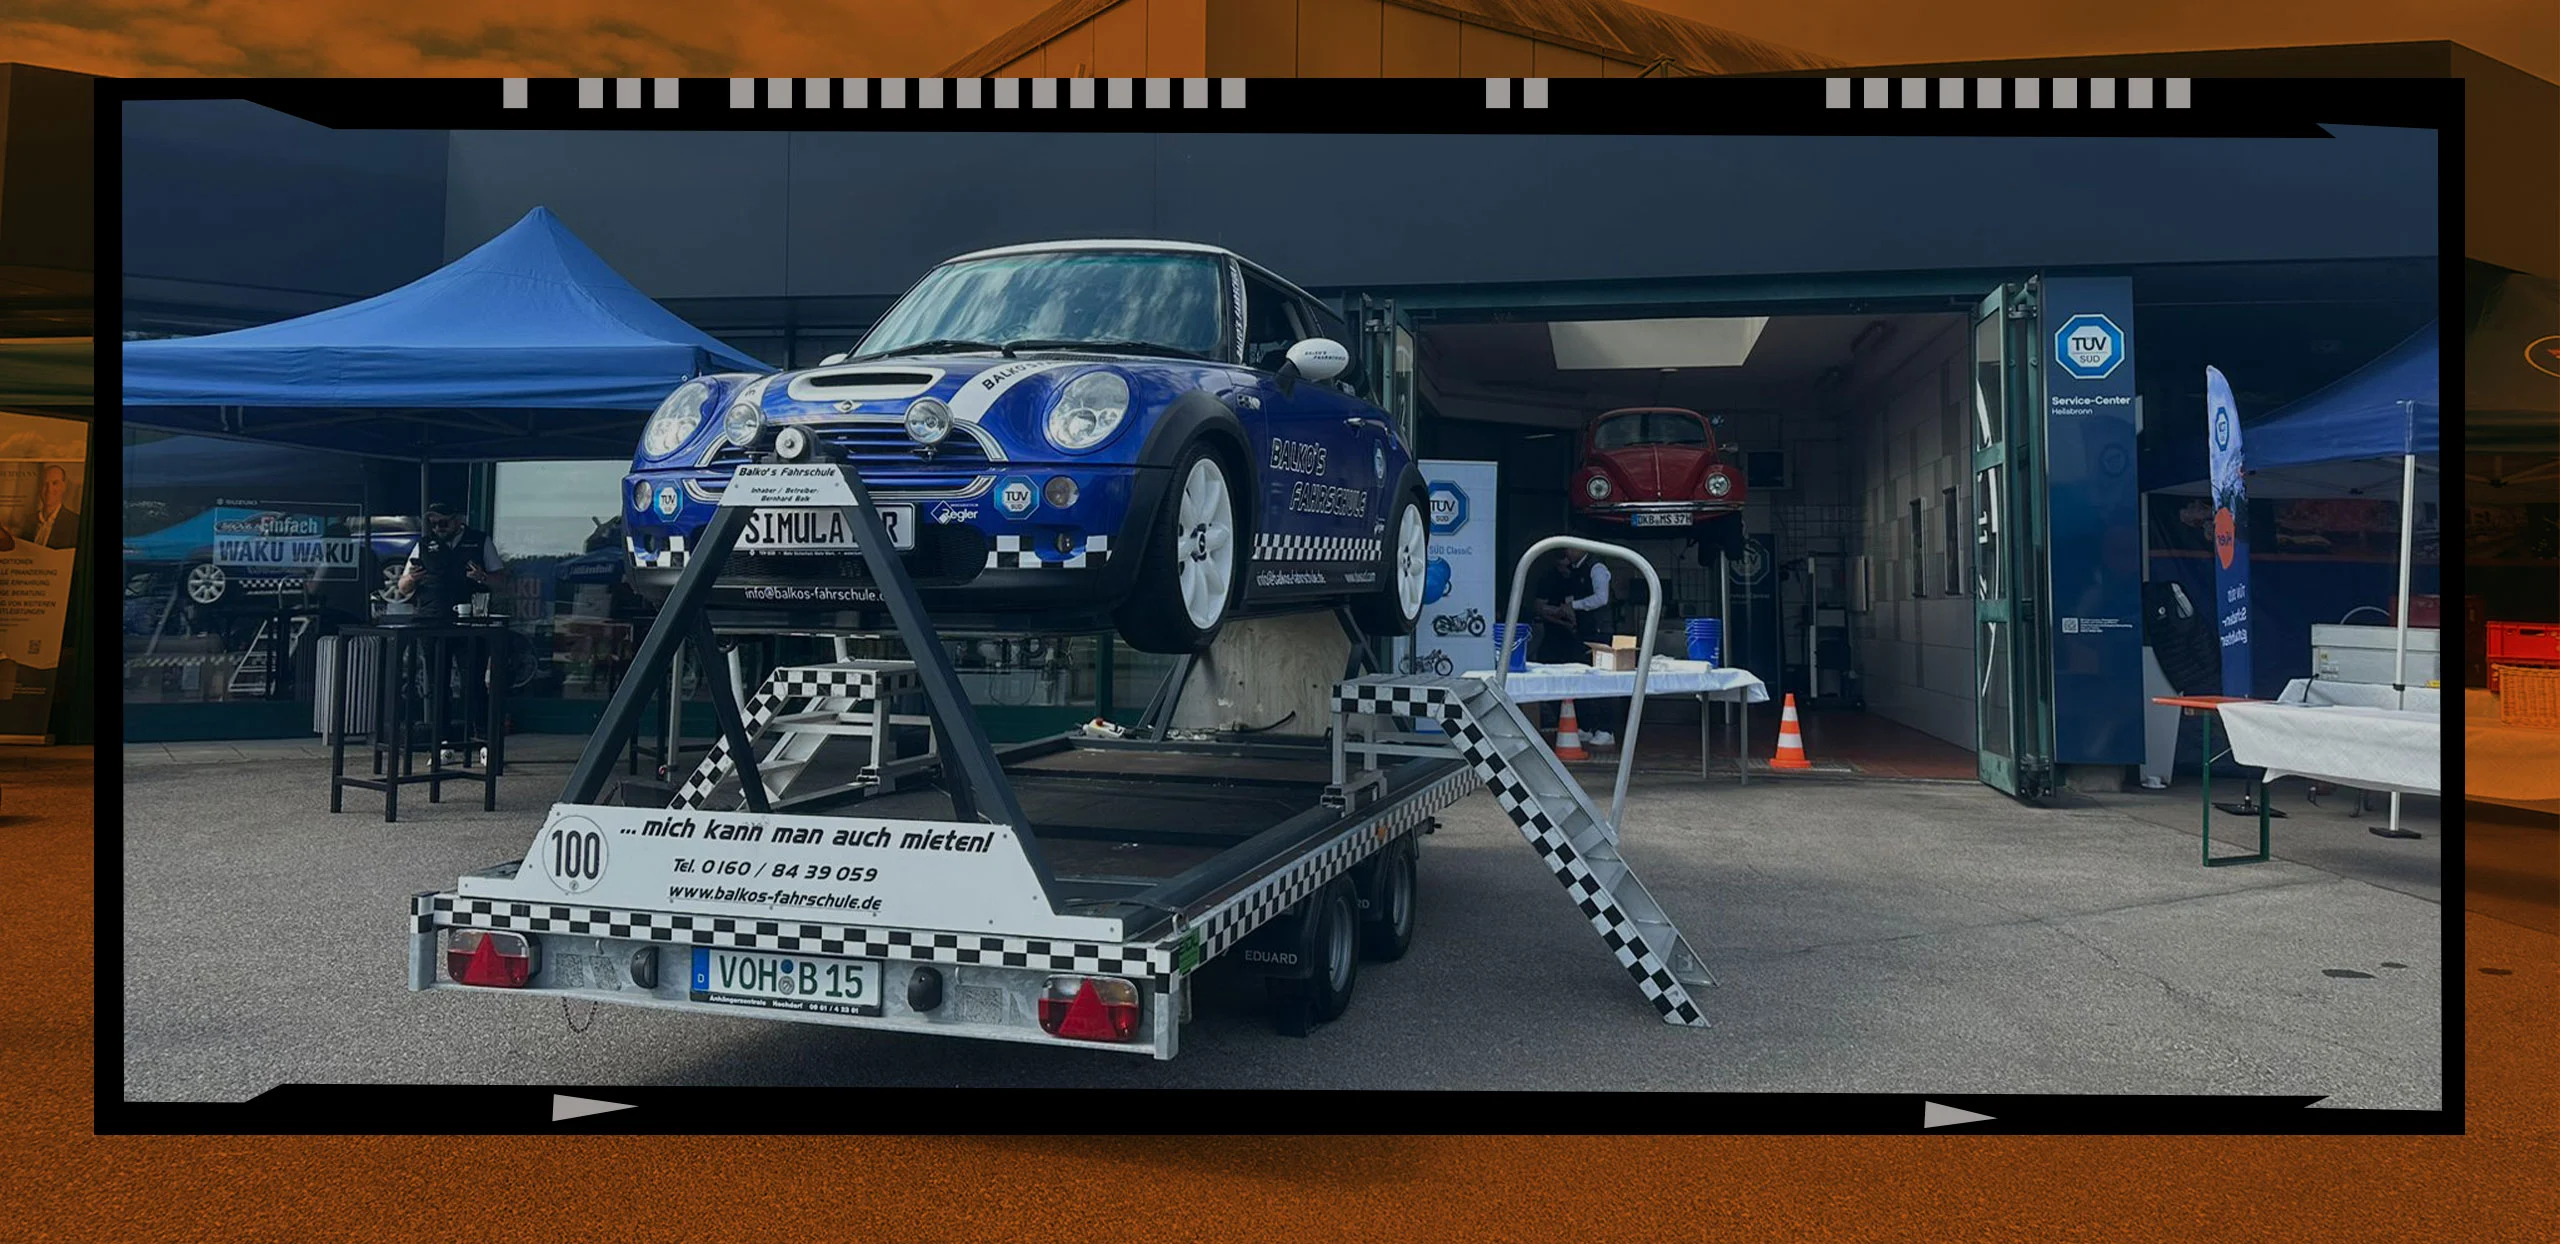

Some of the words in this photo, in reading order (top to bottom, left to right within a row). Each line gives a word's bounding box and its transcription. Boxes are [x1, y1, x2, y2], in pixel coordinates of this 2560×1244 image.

[2071, 336, 2107, 351] TÜV
[2080, 354, 2101, 364] SÜD
[2051, 395, 2131, 406] Service-Center
[1269, 437, 1328, 477] BALKO'S
[739, 467, 777, 476] Balko's
[780, 467, 836, 476] Fahrschule
[1006, 490, 1029, 502] TÜV
[1288, 481, 1369, 518] FAHRSCHULE
[261, 516, 319, 535] Einfach
[220, 541, 284, 562] WAKU
[292, 541, 354, 563] WAKU
[641, 817, 697, 839] mich
[703, 819, 764, 842] kann
[770, 826, 824, 845] man
[832, 827, 892, 848] auch
[899, 829, 995, 853] mieten!
[551, 829, 600, 880] 100
[673, 858, 695, 873] Tel.
[702, 859, 751, 877] 0160
[771, 862, 799, 879] 84
[804, 865, 832, 880] 39
[835, 867, 878, 883] 059
[669, 885, 883, 912] www.balkos-fahrschule.de
[1244, 949, 1298, 965] EDUARD
[719, 954, 778, 992] VOH
[799, 961, 818, 996] B
[825, 963, 864, 999] 15
